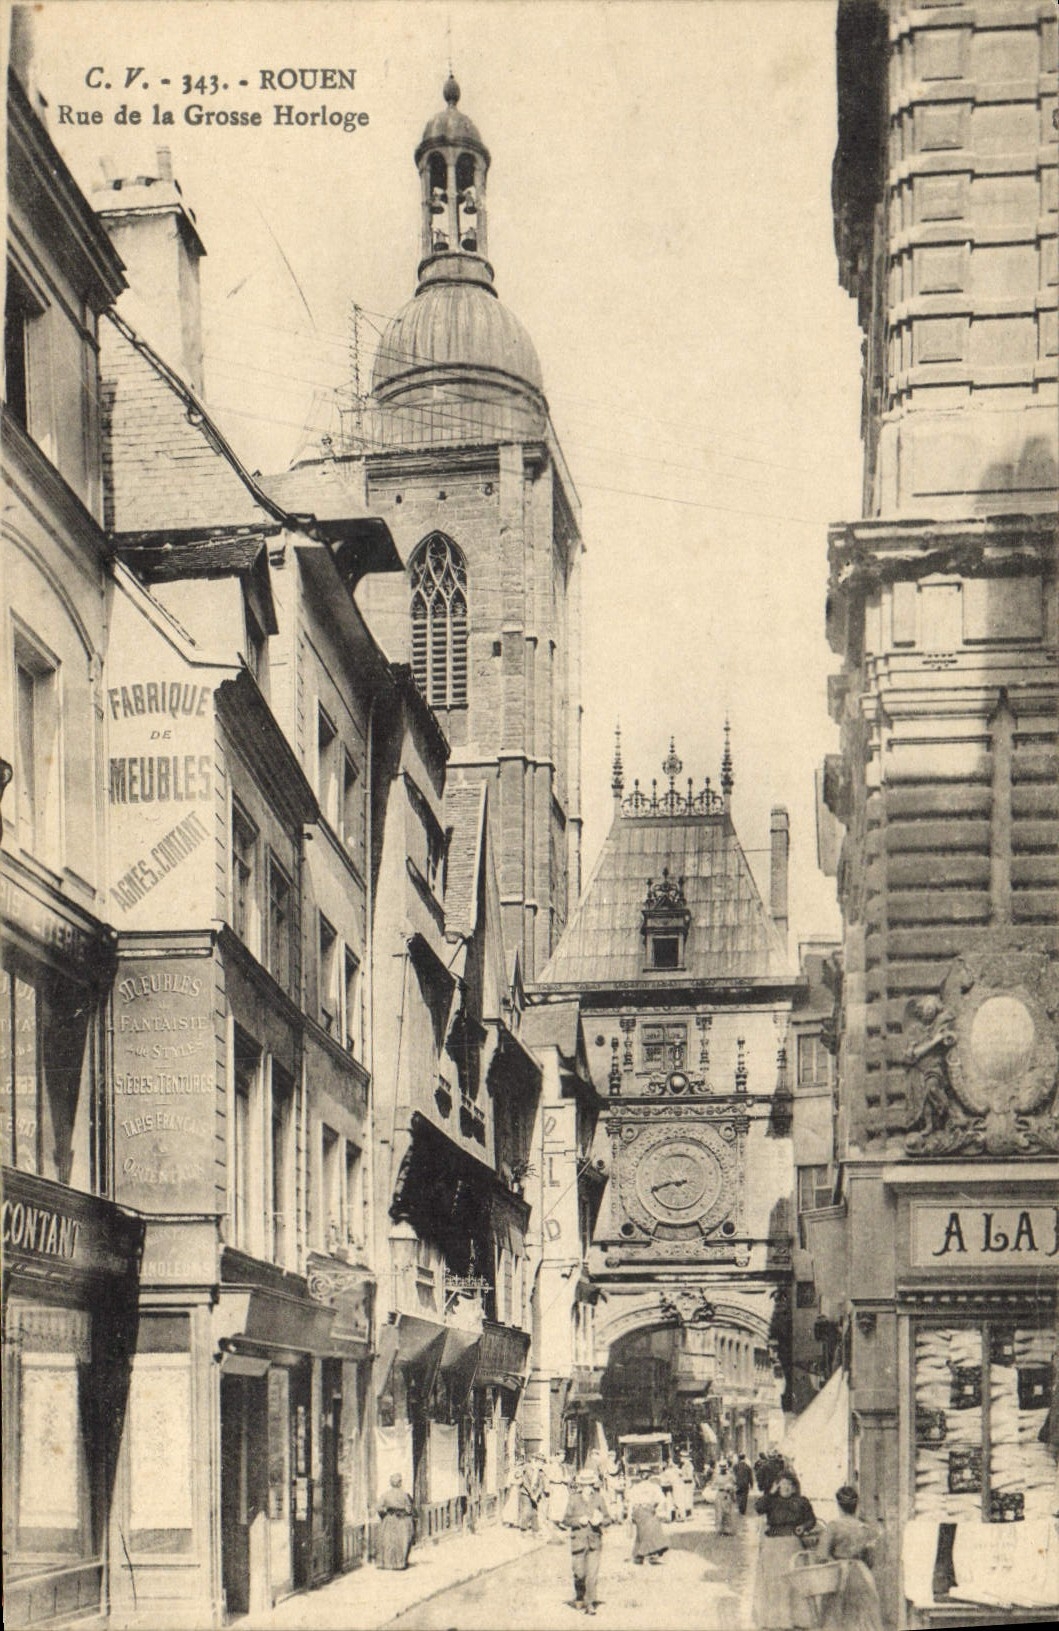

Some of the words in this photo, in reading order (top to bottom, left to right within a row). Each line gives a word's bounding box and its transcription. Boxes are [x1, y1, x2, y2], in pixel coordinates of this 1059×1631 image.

[107, 681, 212, 721] FABRIQUE
[150, 730, 172, 741] DE
[109, 754, 213, 805] MEUBLES
[150, 810, 212, 874] CONTANT
[118, 972, 202, 1004] MEUBLES
[120, 1015, 208, 1032] FANTAISIE
[122, 1114, 154, 1138] TAPIS
[1, 1200, 83, 1258] CONTANT
